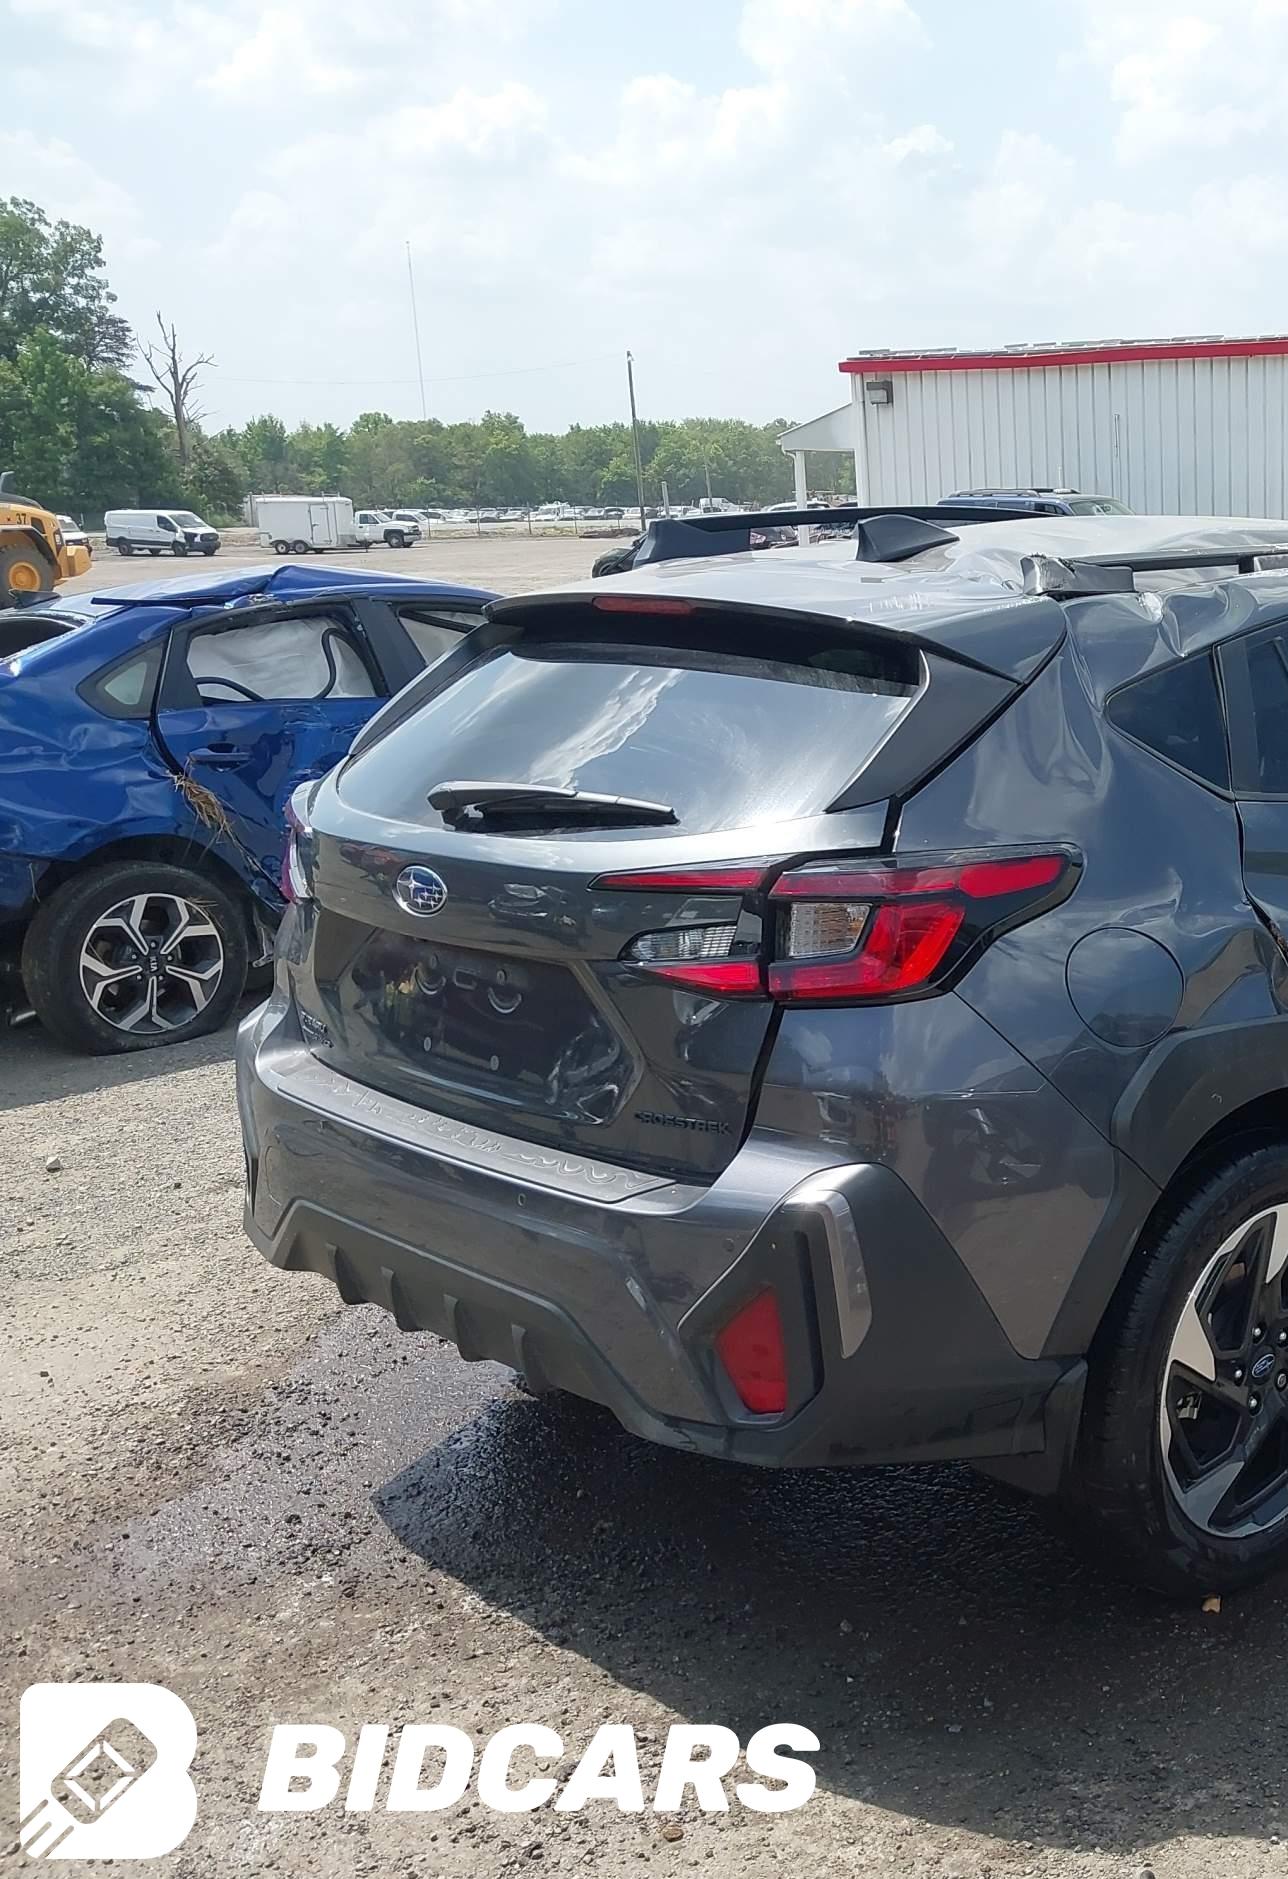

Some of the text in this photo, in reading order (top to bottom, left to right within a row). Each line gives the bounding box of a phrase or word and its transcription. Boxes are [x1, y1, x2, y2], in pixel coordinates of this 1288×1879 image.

[15, 513, 27, 524] 37
[149, 956, 158, 972] KIA
[634, 1110, 733, 1134] CROSSTREK
